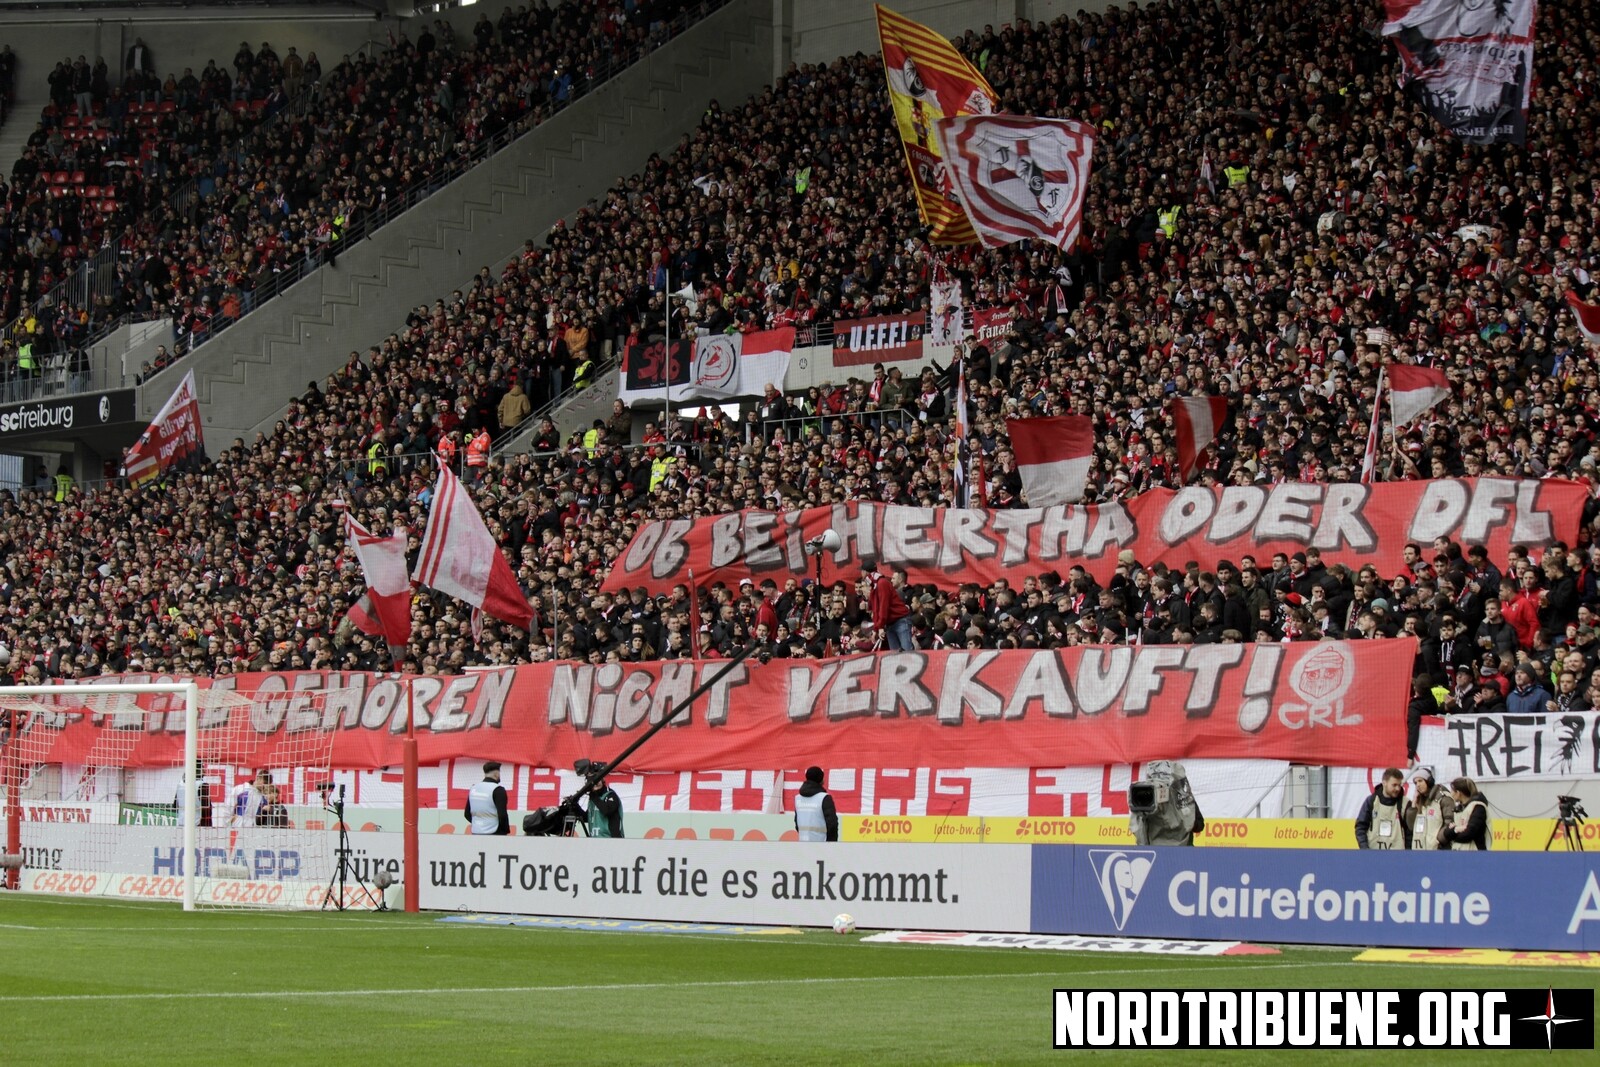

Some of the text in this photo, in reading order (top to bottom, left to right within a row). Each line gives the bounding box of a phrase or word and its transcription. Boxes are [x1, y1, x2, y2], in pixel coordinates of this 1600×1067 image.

[624, 518, 696, 580] OB
[830, 500, 1138, 571] HERTHA
[1160, 483, 1378, 554] ODER
[1408, 477, 1556, 548] DFL
[249, 667, 517, 735] GEHÖREN
[787, 643, 1287, 735] VERKAUFT!
[1277, 700, 1364, 730] CRL
[874, 820, 913, 835] LOTTO
[1033, 821, 1076, 836] LOTTO
[1205, 822, 1248, 838] LOTTO
[33, 872, 98, 894] CAZOO
[430, 851, 487, 889] und
[498, 854, 579, 899] Tore,
[591, 855, 647, 895] auf
[657, 857, 708, 897] die
[721, 870, 758, 899] es
[771, 860, 959, 904] ankommt.
[212, 882, 283, 904] CAZOO
[1167, 869, 1491, 926] Clairefontaine
